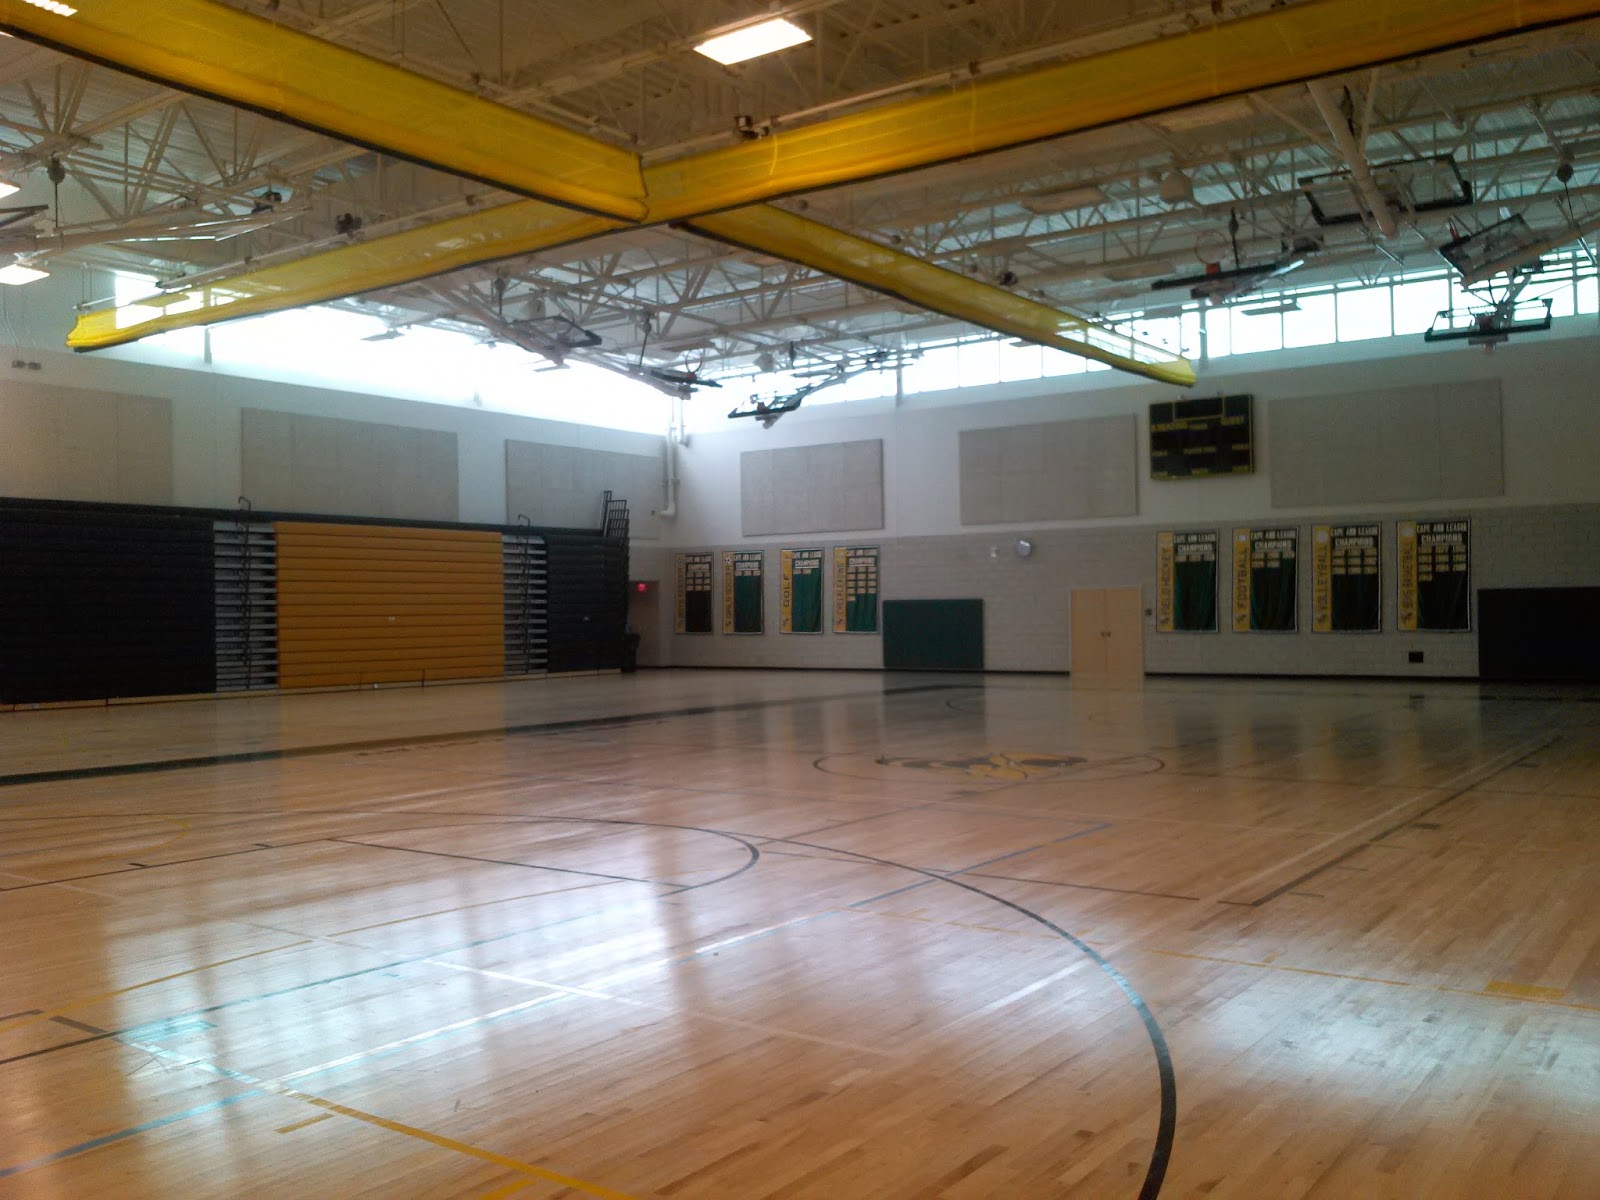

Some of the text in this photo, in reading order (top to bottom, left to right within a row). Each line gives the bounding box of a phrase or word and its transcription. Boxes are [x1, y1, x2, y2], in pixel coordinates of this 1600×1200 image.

[1335, 537, 1374, 547] CHAMPIONS
[1421, 533, 1462, 544] CHAMPIONS
[1177, 543, 1213, 554] CHAMPIONS
[1255, 540, 1291, 550] CHAMPIONS
[1237, 547, 1247, 609] FOOTBALL
[1317, 545, 1328, 612] VOLLEYBALL
